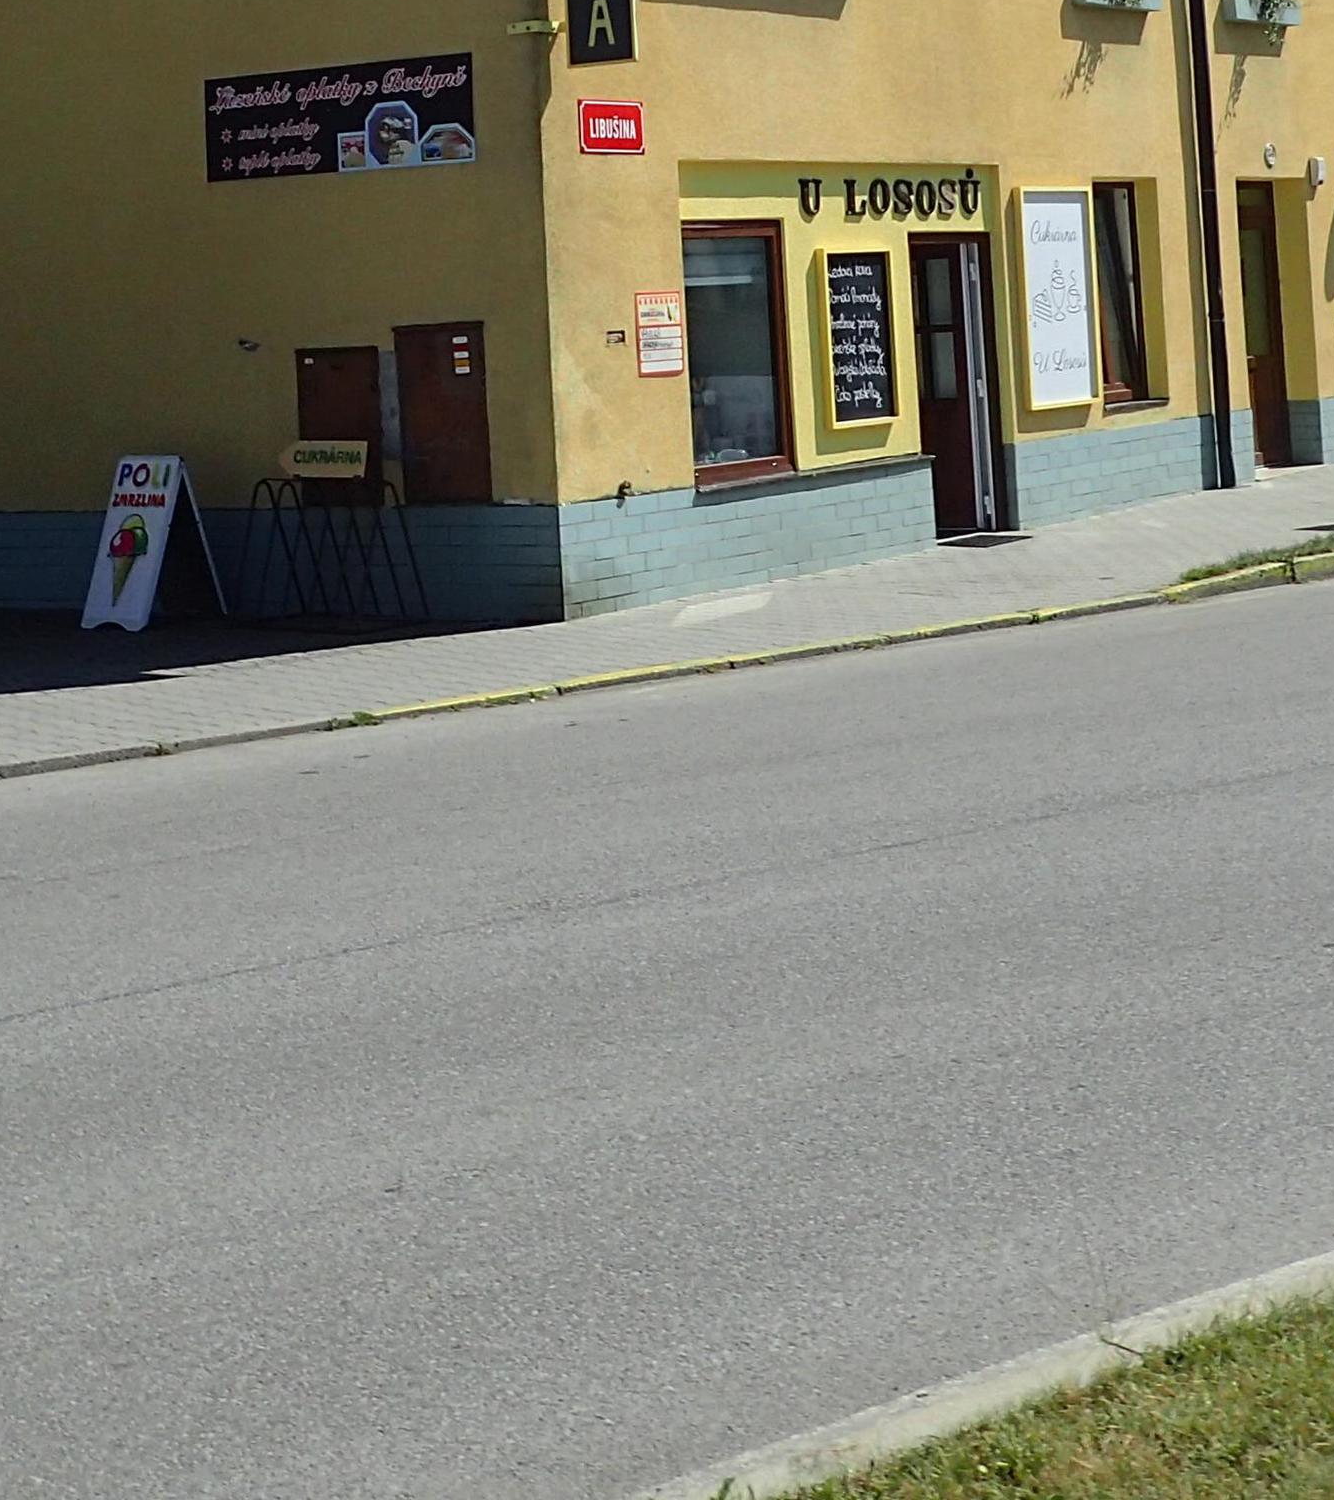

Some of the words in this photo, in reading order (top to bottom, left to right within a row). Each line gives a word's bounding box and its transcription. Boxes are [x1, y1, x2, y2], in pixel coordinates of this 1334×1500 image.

[295, 73, 363, 111] oplatky
[363, 79, 379, 97] z
[381, 64, 468, 99] Bechyně
[237, 124, 268, 142] mini
[269, 116, 321, 145] oplatky
[588, 114, 637, 140] LIBUŠINA
[270, 147, 322, 174] oplatky
[798, 178, 823, 217] U
[843, 167, 982, 217] LOSOSŮ
[292, 446, 362, 466] CUKRÁRNA
[117, 462, 171, 488] POLI
[111, 493, 167, 509] ZMRZLINA
